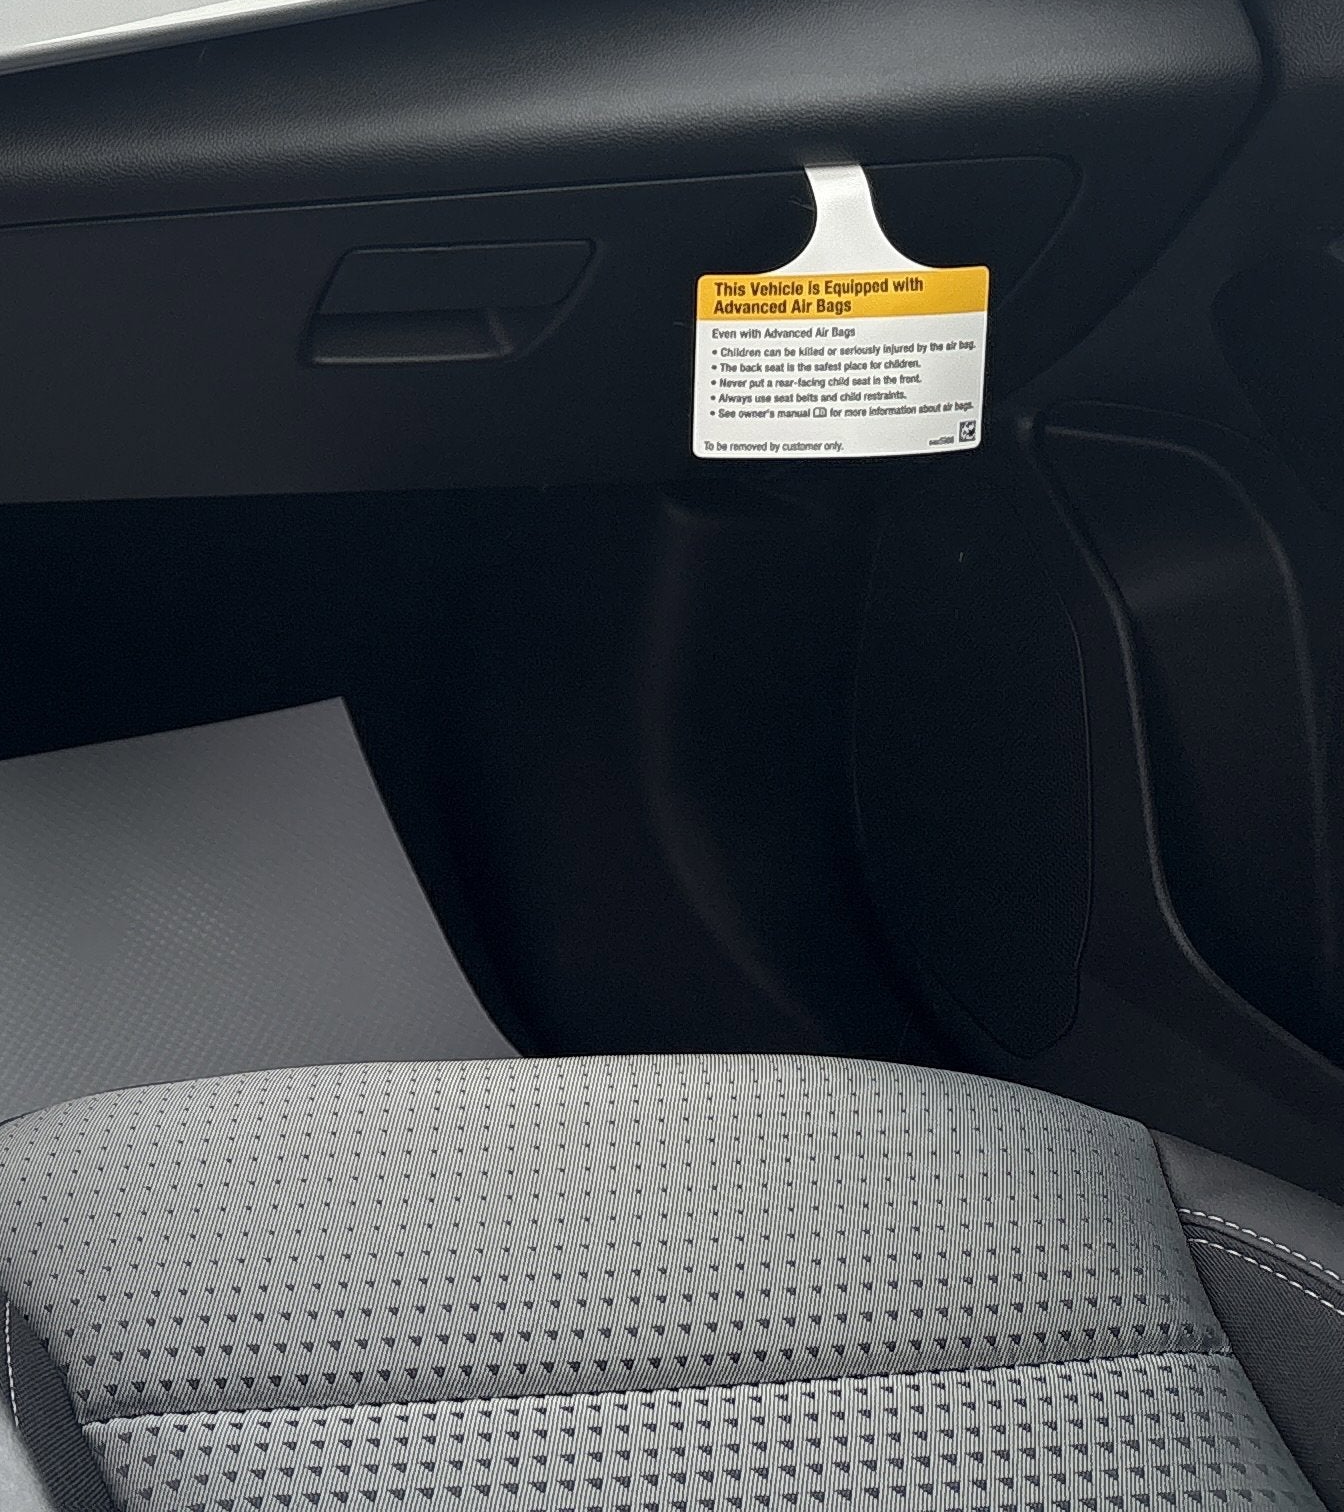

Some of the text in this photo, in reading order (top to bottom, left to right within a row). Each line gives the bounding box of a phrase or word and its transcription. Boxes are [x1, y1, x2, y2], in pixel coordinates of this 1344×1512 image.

[714, 277, 924, 297] This Vehicle is Equipped with
[713, 298, 851, 315] Advanced Air Bags
[712, 327, 855, 339] Even with Advanced Air Bags
[720, 347, 761, 357] Children
[764, 348, 781, 357] can
[784, 347, 796, 357] be
[799, 346, 824, 357] killed
[827, 348, 837, 356] or
[840, 345, 881, 356] seriously
[883, 343, 914, 355] injured
[917, 342, 927, 354] by
[930, 342, 943, 352] the
[946, 341, 957, 350] air
[720, 359, 921, 372] The back seat is the safest place for children.
[719, 378, 747, 387] Never
[749, 379, 764, 389] put
[775, 378, 825, 388] rear-facing
[828, 377, 849, 386] child
[852, 376, 871, 385] seat
[873, 375, 881, 385] in
[883, 375, 897, 384] the
[899, 374, 922, 384] front.
[718, 390, 907, 405] Always use seat belts and child restraints.
[718, 408, 736, 418] See
[777, 409, 810, 418] manual
[830, 408, 842, 417] for
[844, 408, 866, 417] more
[869, 405, 916, 416] information
[919, 403, 941, 414] about
[943, 402, 953, 412] air
[704, 441, 844, 453] To be removed by customer only.
